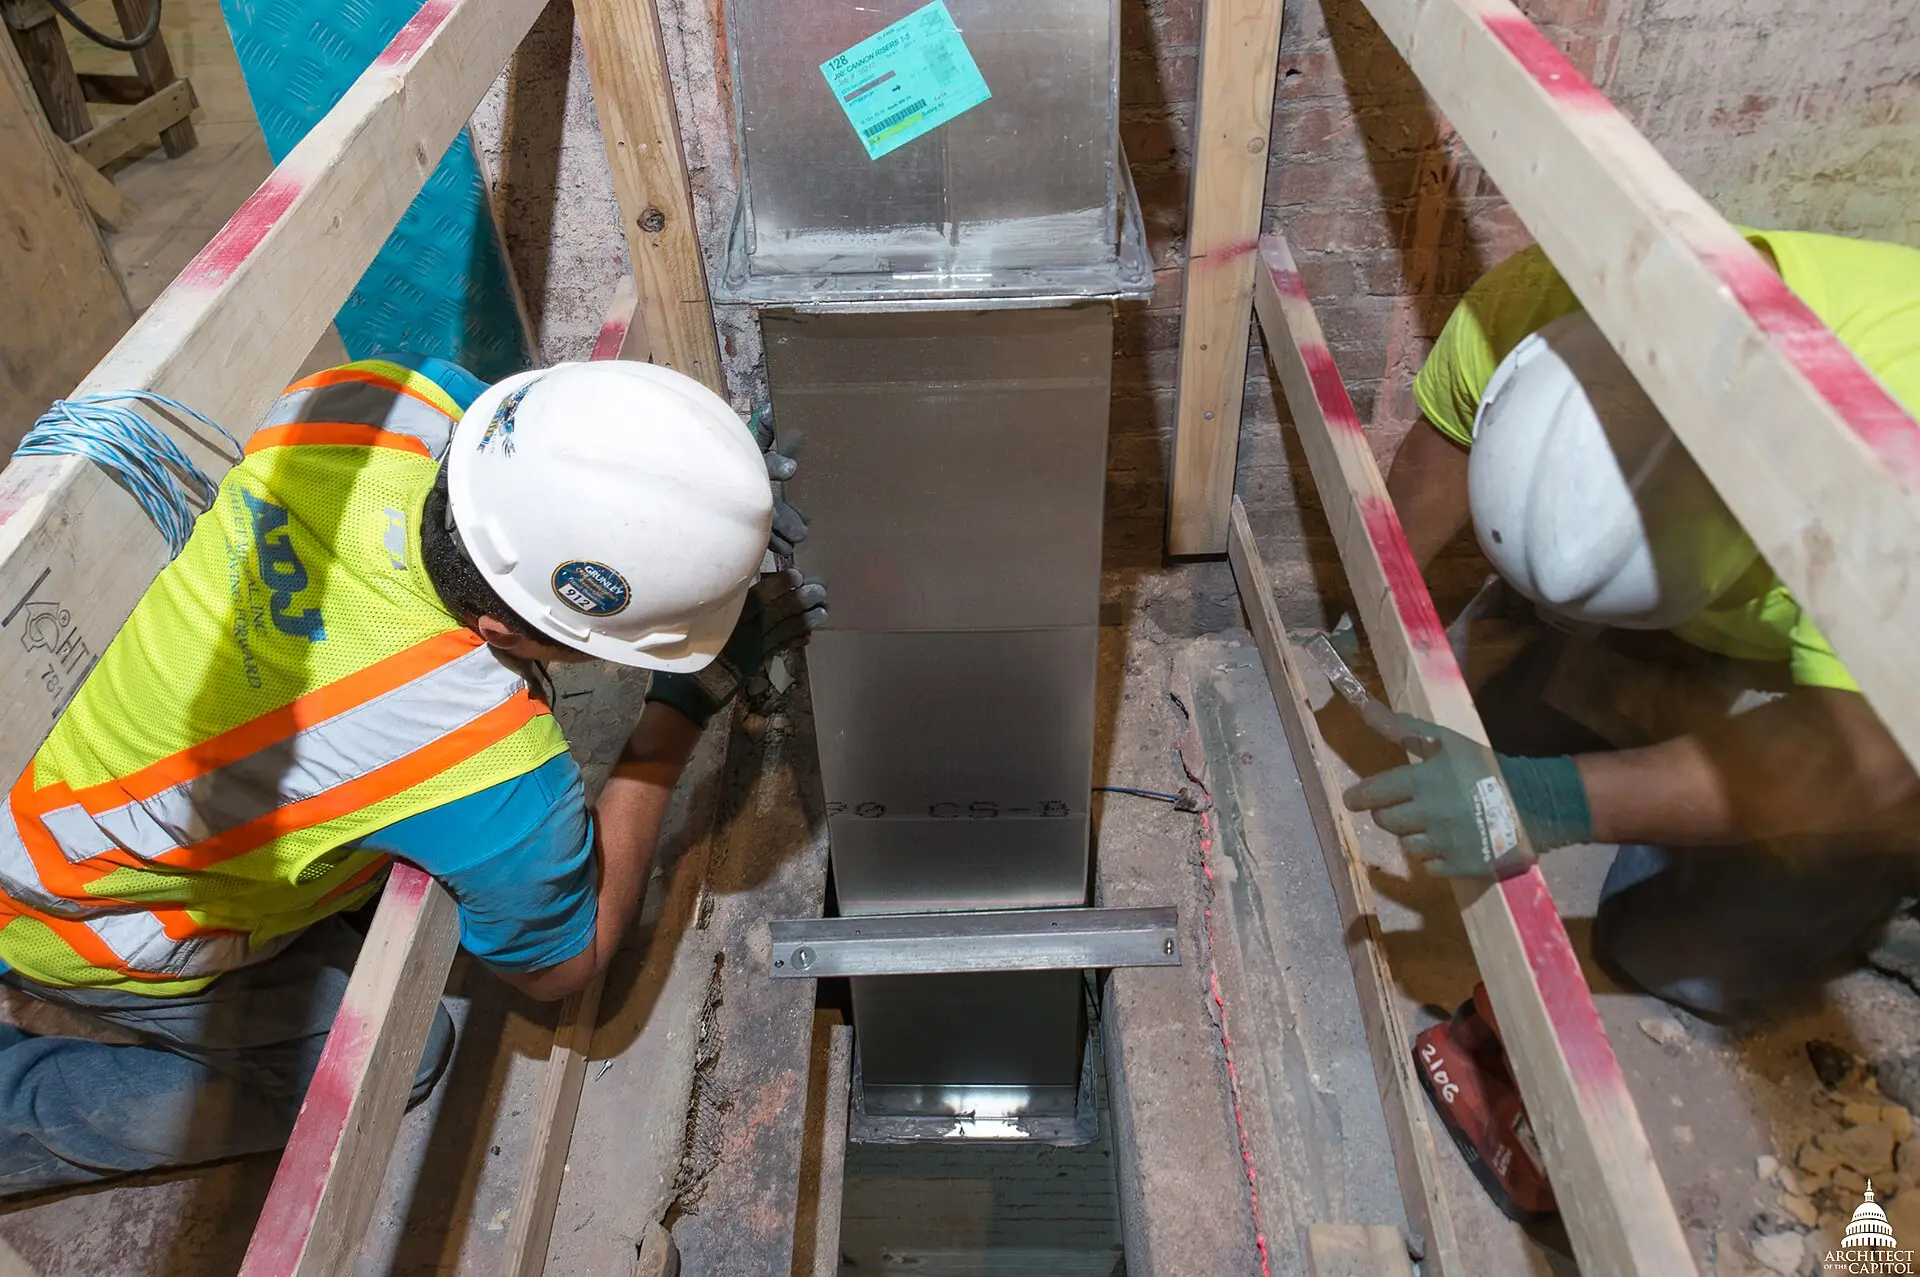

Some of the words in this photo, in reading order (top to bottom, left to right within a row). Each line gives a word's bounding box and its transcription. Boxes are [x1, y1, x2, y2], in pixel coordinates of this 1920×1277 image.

[828, 54, 849, 72] 128
[846, 52, 875, 73] CANNON
[875, 39, 900, 57] RISERS
[900, 32, 911, 43] 1-5
[241, 487, 327, 643] ADJ
[584, 565, 624, 595] GRUNLEY
[565, 588, 590, 607] 912
[55, 626, 90, 674] HT
[41, 663, 64, 700] 781
[1421, 1043, 1460, 1104] 2106
